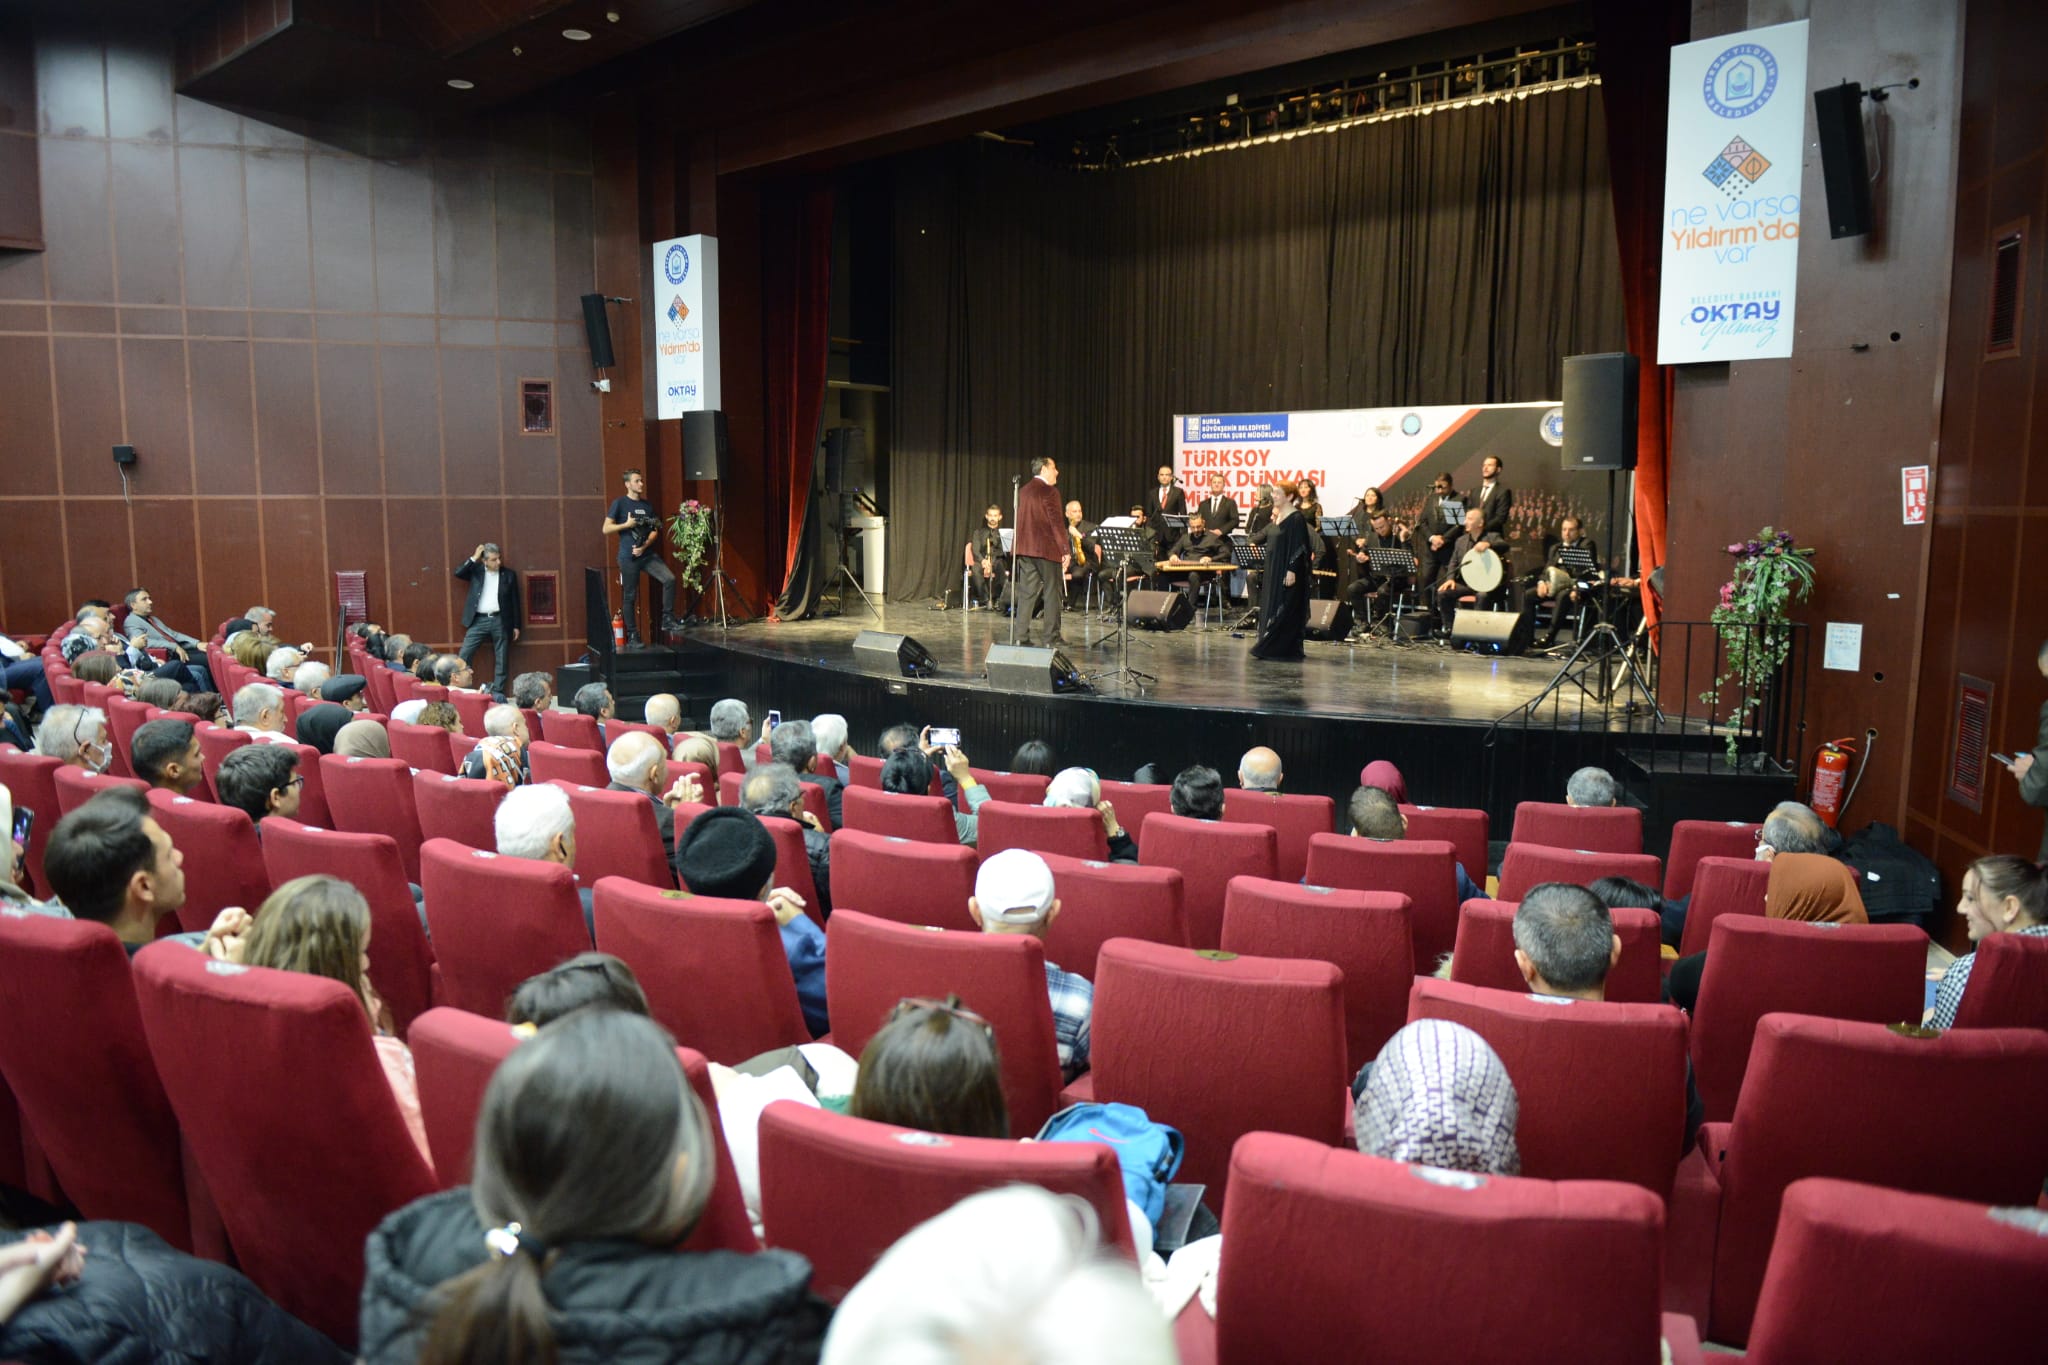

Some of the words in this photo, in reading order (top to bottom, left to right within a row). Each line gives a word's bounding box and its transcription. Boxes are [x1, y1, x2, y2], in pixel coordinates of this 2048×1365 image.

[1671, 205, 1708, 228] ne
[1715, 194, 1800, 222] varsa
[1670, 217, 1800, 251] Yıldırım'da
[1714, 245, 1756, 264] var
[1690, 300, 1781, 323] OKTAY
[667, 385, 697, 396] OKTAY
[1182, 449, 1271, 467] TÜRKSOY
